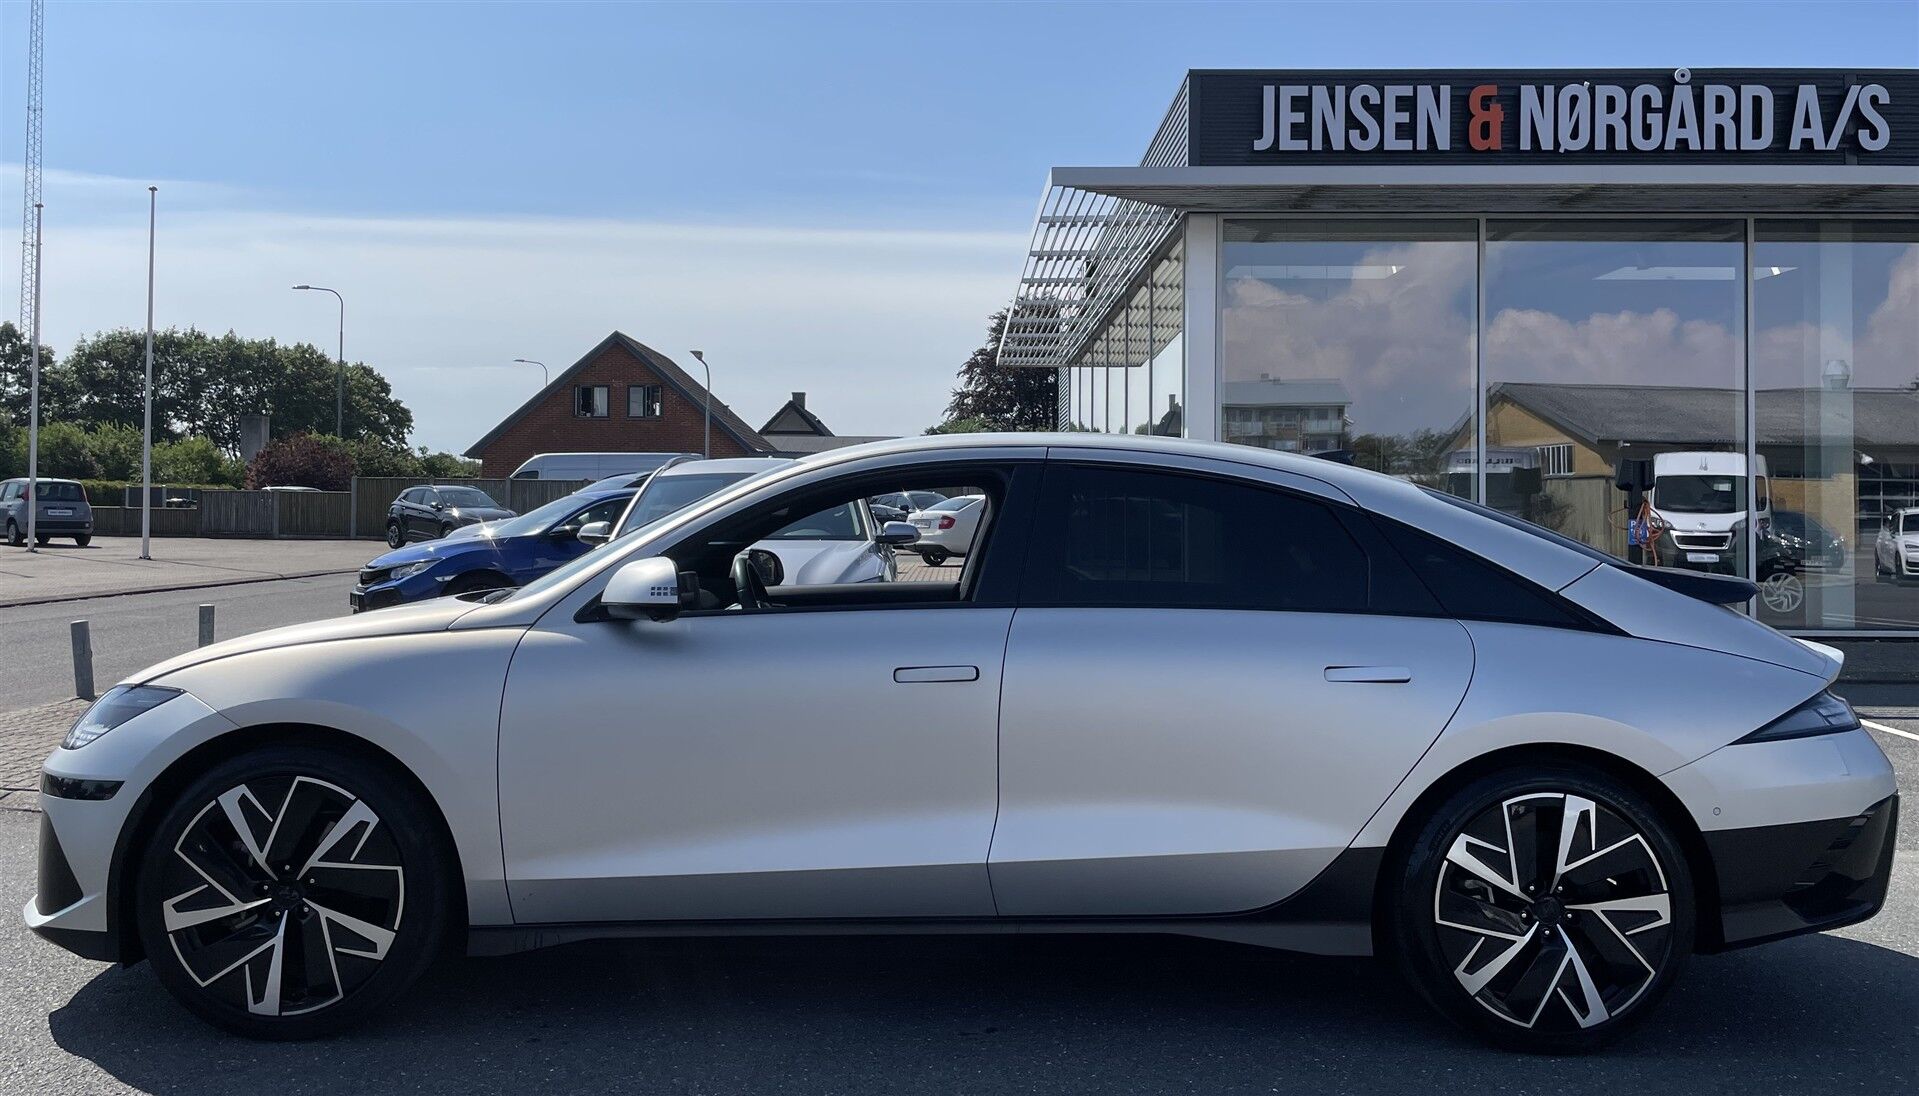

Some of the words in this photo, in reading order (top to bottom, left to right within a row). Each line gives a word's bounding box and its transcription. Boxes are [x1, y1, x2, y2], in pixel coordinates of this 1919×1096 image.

[1253, 84, 1451, 151] JENSEN
[1469, 84, 1504, 151] &
[1519, 67, 1774, 154] NØRGÅRD
[1788, 83, 1891, 151] A/S
